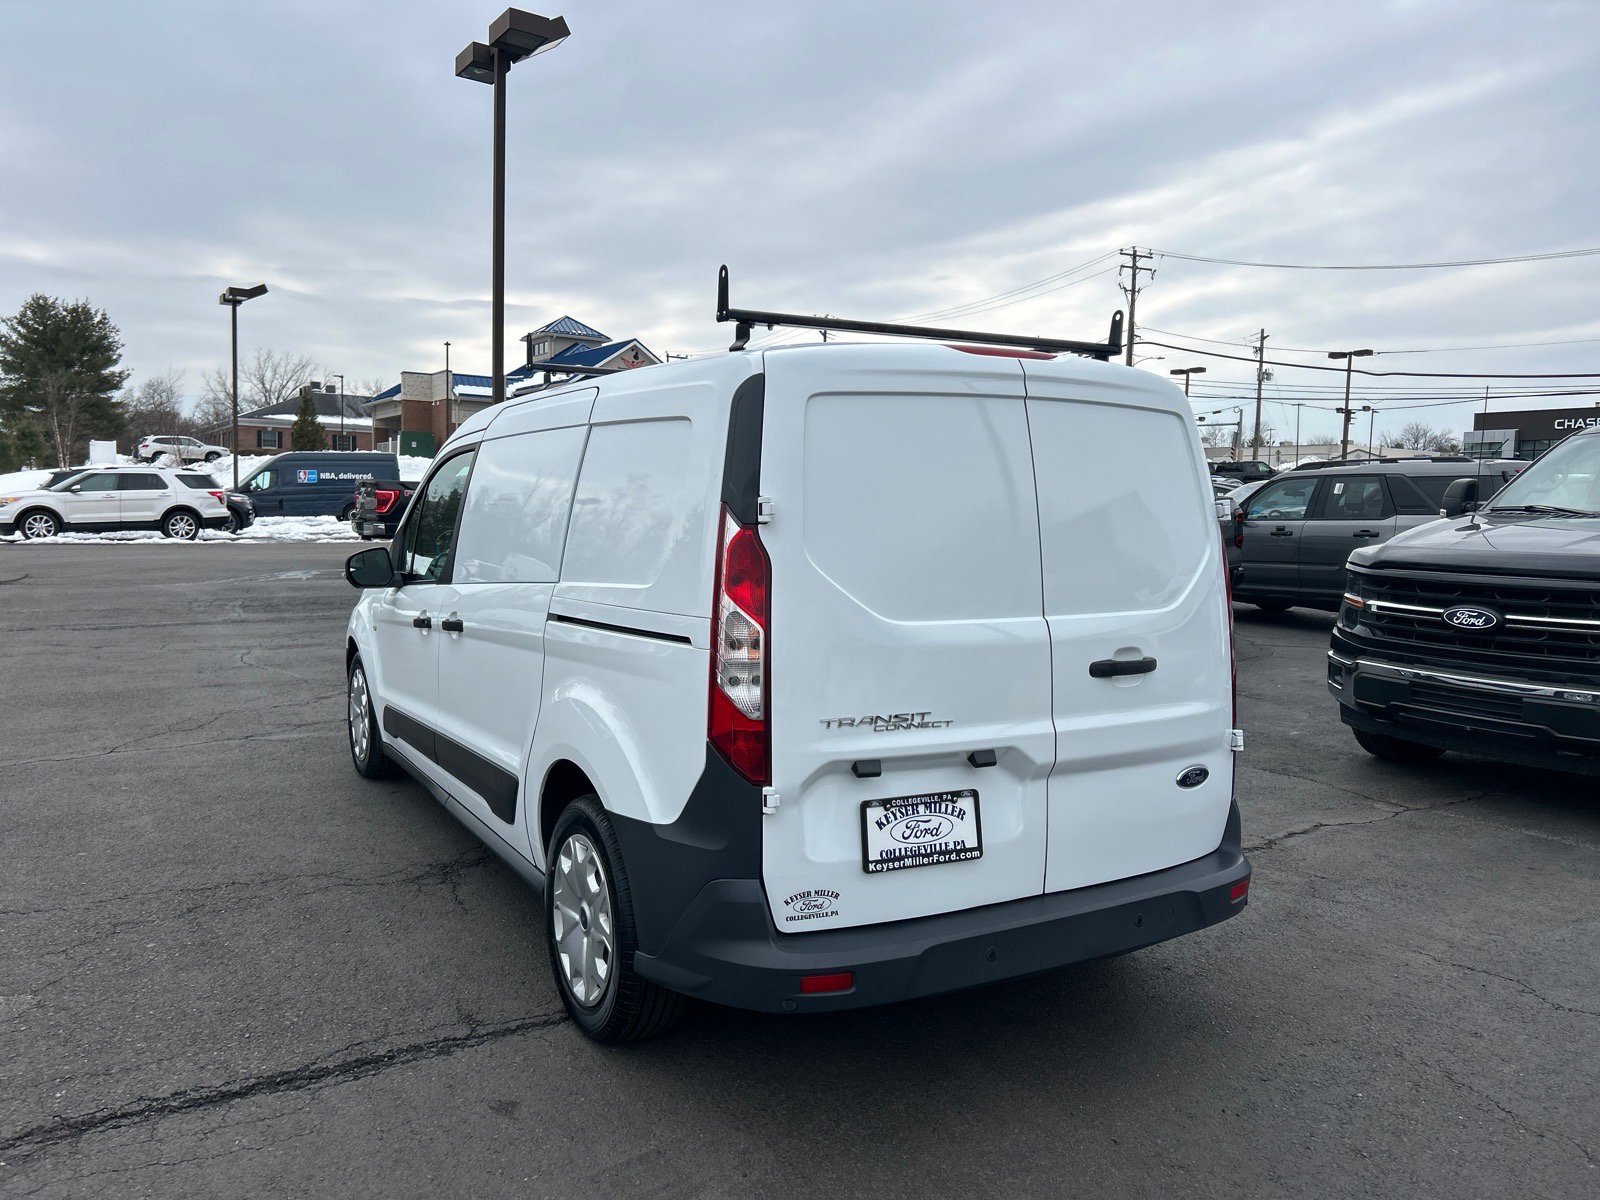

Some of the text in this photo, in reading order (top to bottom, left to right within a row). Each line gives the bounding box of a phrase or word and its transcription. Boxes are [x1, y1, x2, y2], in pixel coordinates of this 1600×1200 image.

[320, 472, 338, 480] NBA,
[338, 472, 374, 480] delivered.
[1453, 610, 1486, 626] Ford
[820, 711, 932, 729] TRANSIT
[873, 720, 954, 732] CONNECT
[942, 793, 952, 801] PA
[875, 802, 967, 831] KEYSER MILLER
[901, 818, 942, 840] Ford
[868, 850, 980, 872] KeyserMillerFord.com
[783, 889, 840, 906] KEYSER MILLER
[799, 899, 825, 911] Ford
